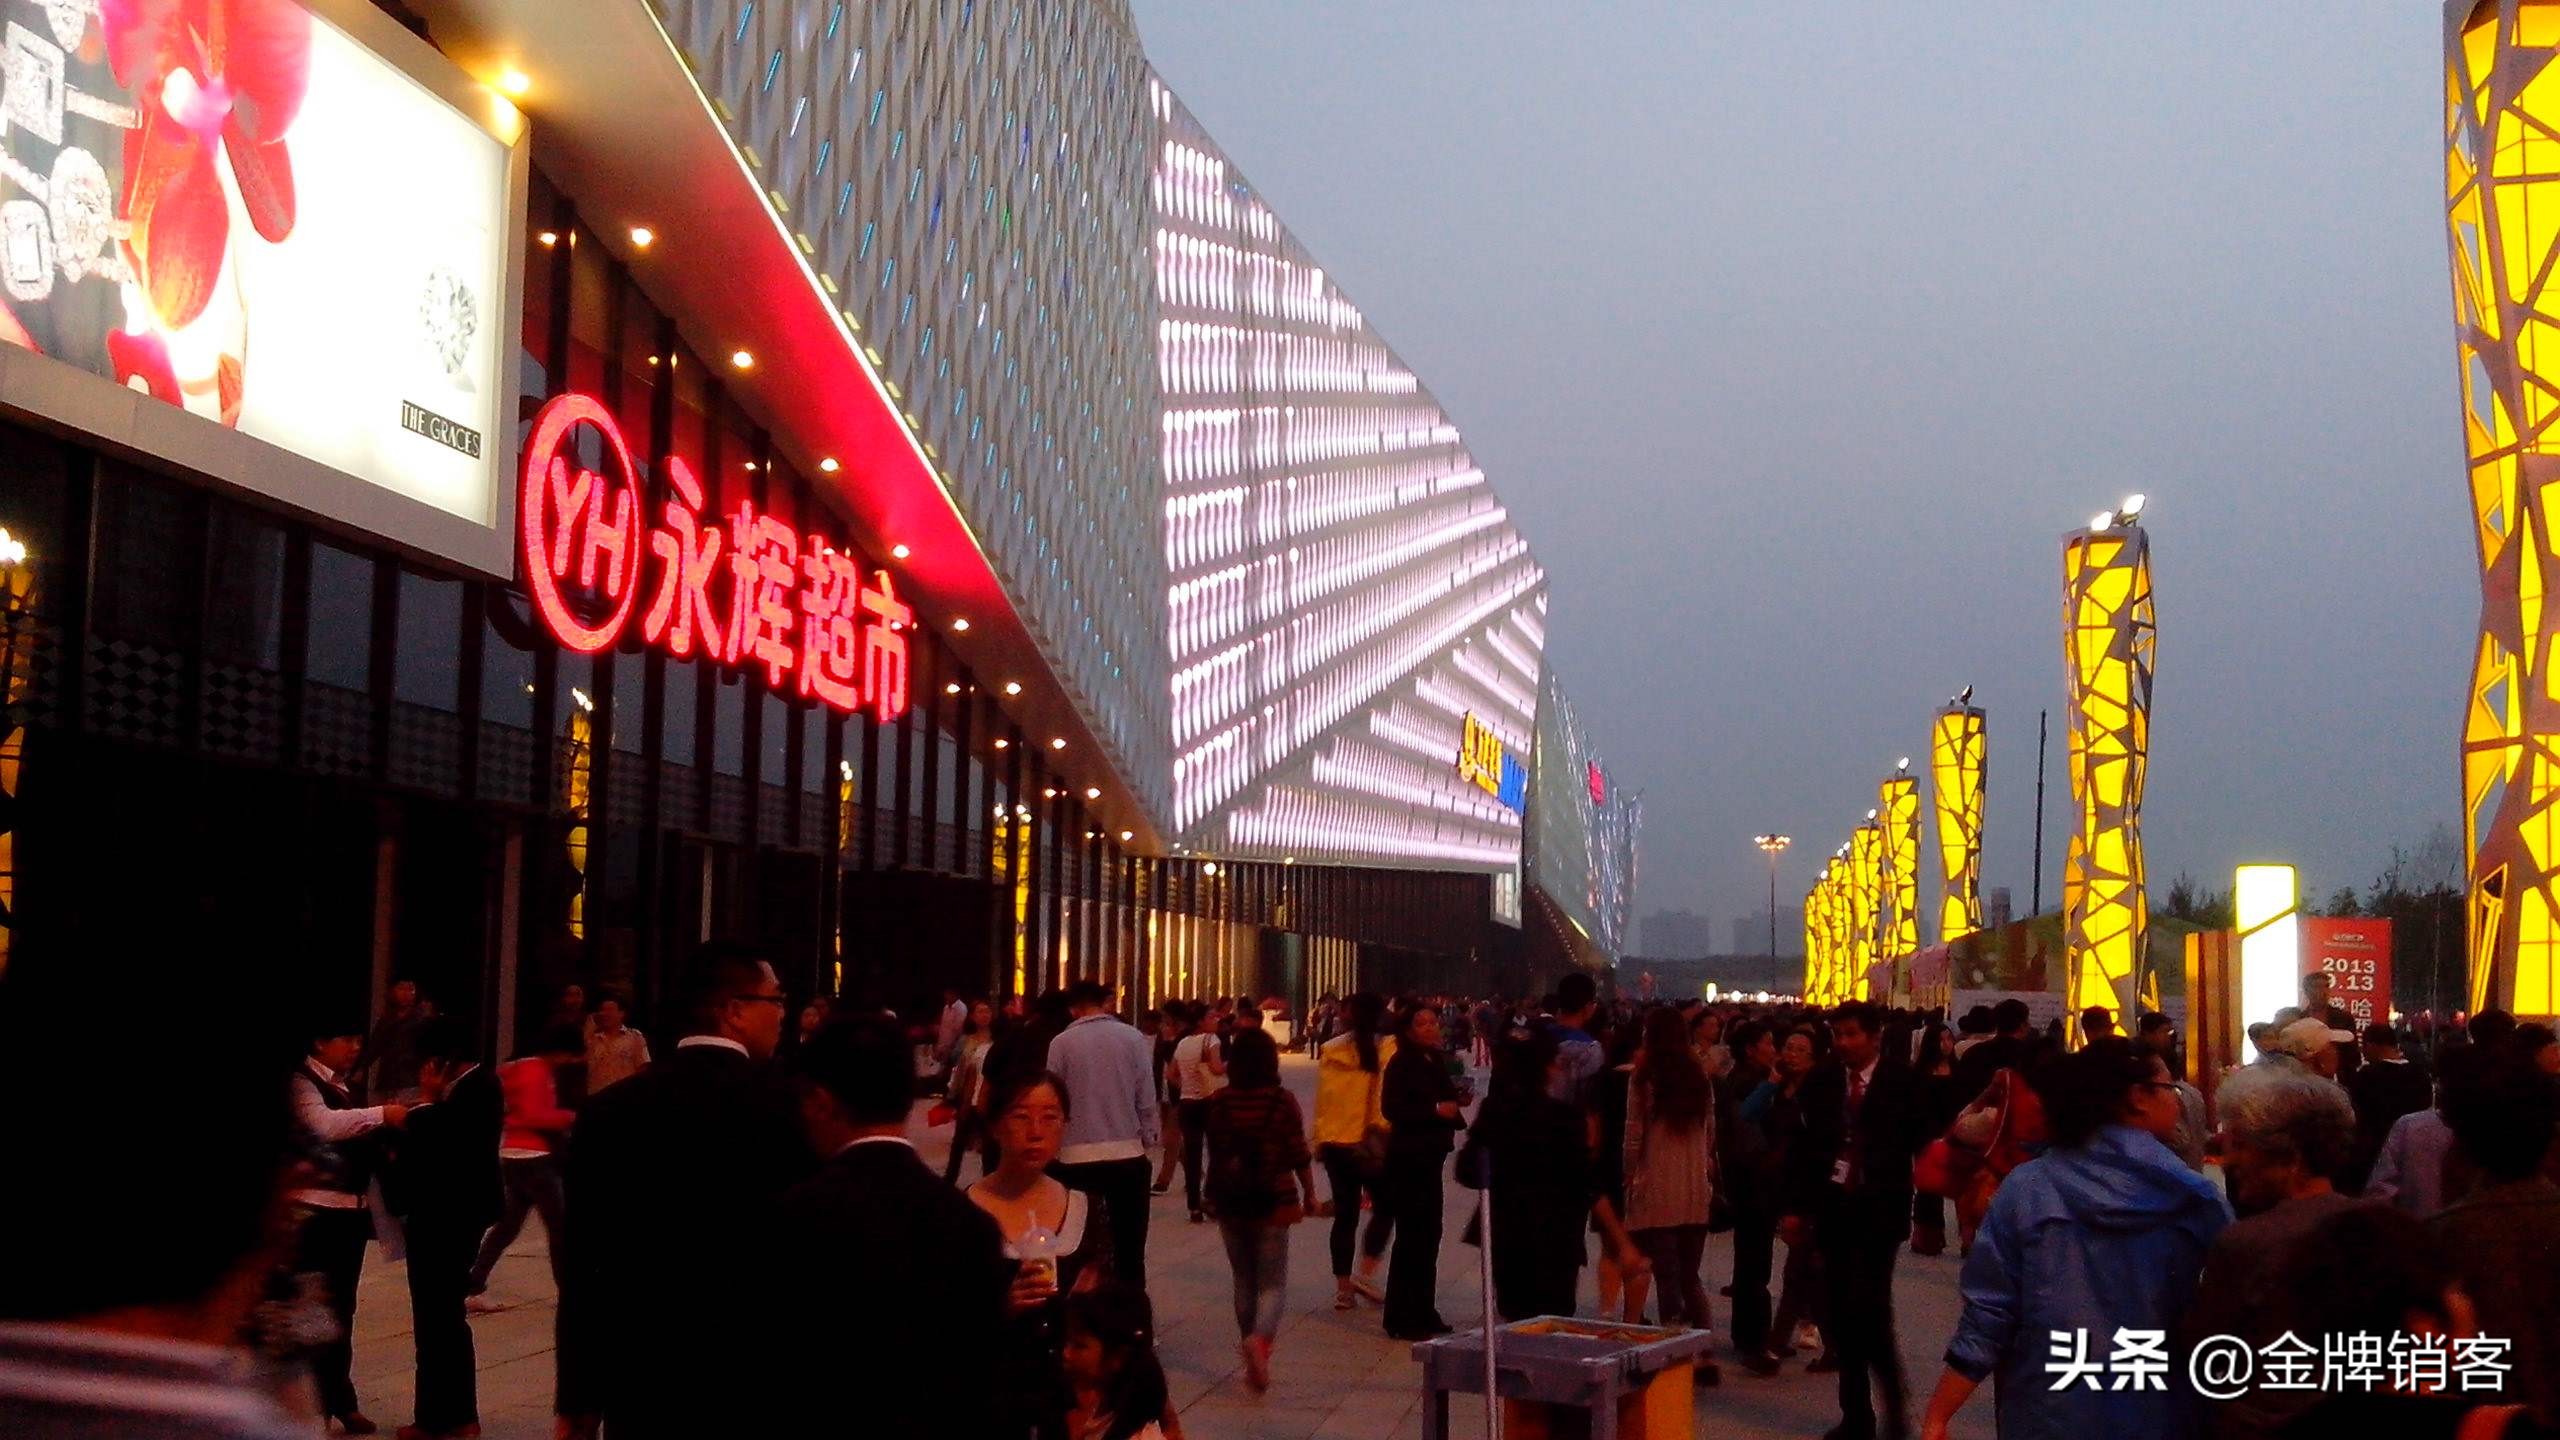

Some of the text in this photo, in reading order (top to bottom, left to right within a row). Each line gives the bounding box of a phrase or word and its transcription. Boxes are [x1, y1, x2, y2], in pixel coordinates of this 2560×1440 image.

[402, 403, 480, 456] THE GRACES
[550, 456, 631, 598] YH
[643, 455, 913, 723] 永辉超市
[2322, 956, 2376, 974] 2013
